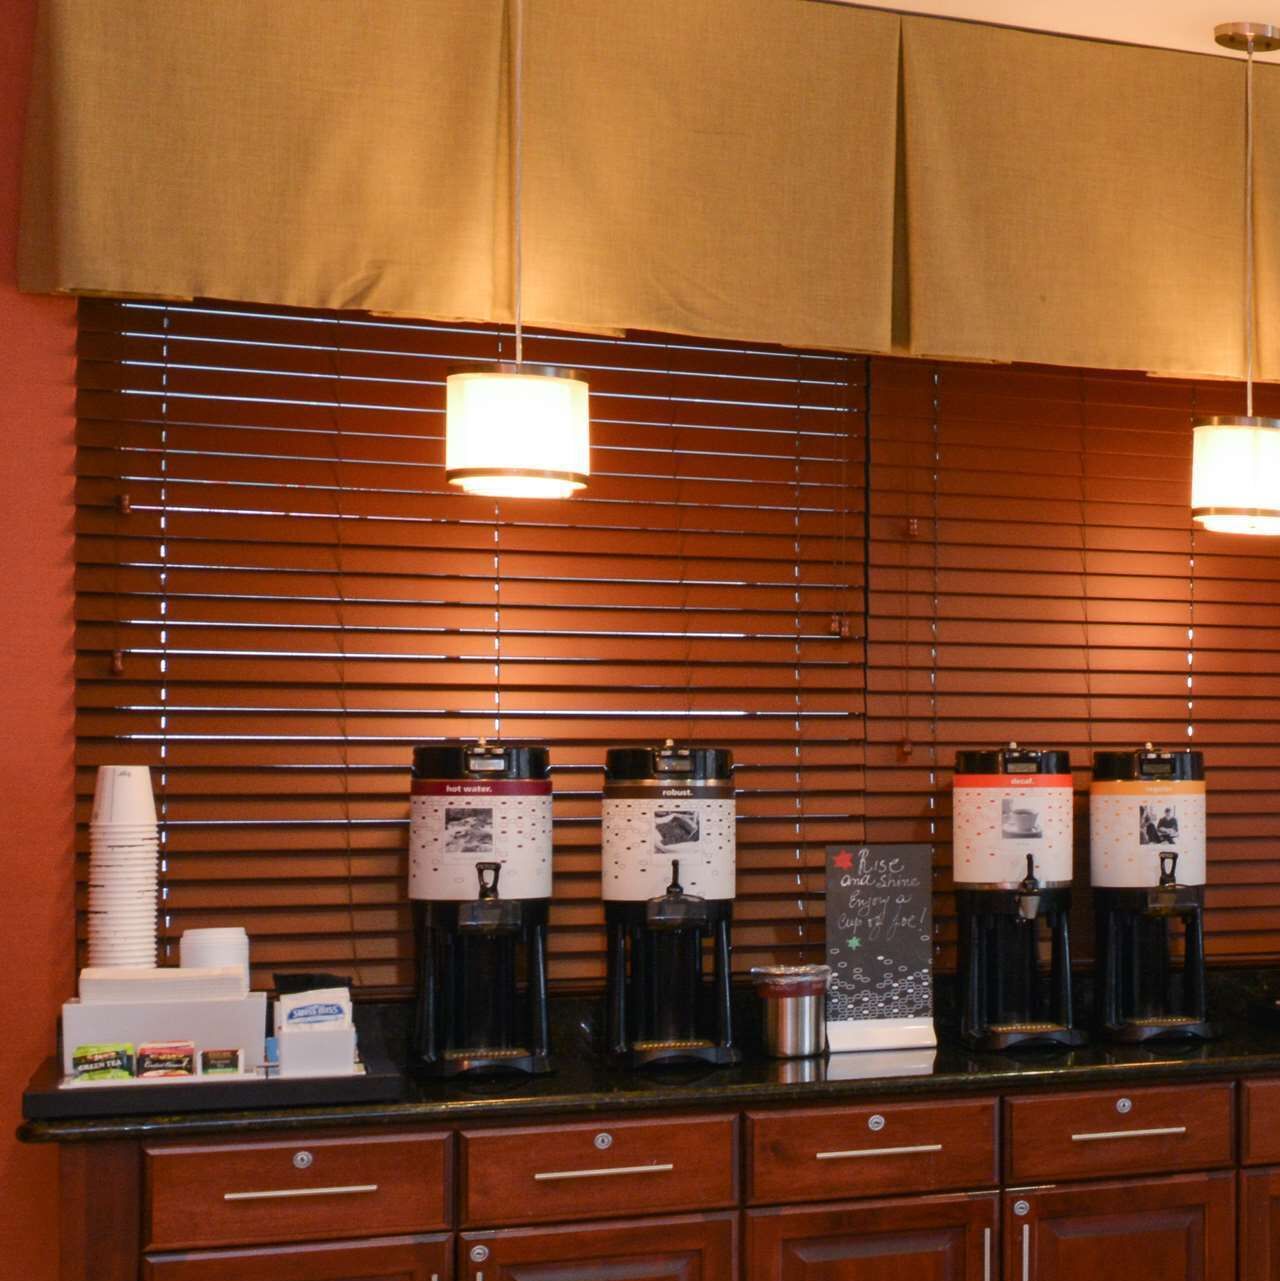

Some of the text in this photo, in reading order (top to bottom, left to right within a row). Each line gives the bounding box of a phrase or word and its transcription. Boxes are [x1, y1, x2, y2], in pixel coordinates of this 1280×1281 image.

[446, 785, 493, 794] hot water.
[662, 788, 693, 797] robust.
